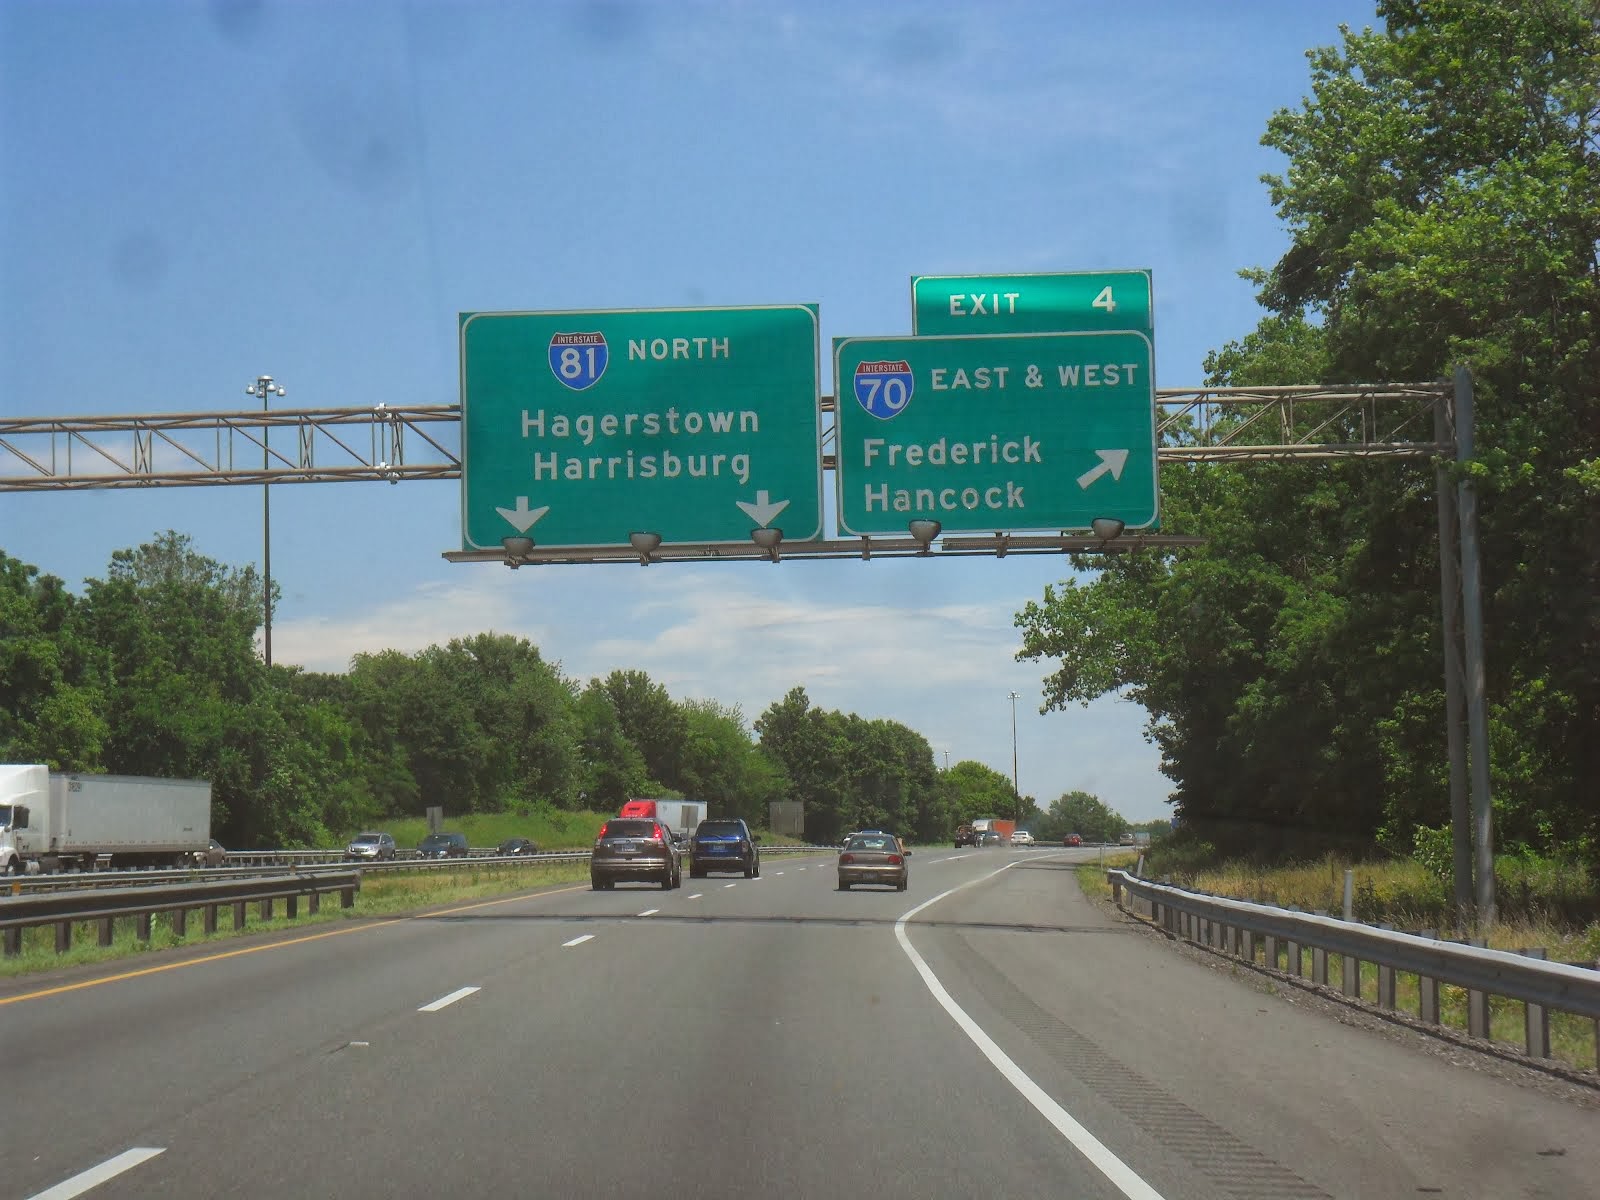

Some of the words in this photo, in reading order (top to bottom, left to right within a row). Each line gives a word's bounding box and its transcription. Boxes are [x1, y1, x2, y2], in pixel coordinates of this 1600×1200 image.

[949, 293, 1020, 315] EXIT
[1092, 286, 1117, 312] 4
[557, 335, 599, 344] INTERSTATE
[628, 337, 730, 360] NORTH
[560, 348, 596, 379] 81
[862, 363, 904, 374] INTERSTATE
[931, 367, 1009, 390] EAST
[1025, 364, 1044, 388] &
[1058, 363, 1139, 386] WEST
[859, 378, 907, 410] 70
[521, 407, 759, 445] Hagerstown
[863, 434, 1042, 467] Frederick
[534, 450, 750, 484] Harrisburg
[865, 481, 1025, 512] Hancock
